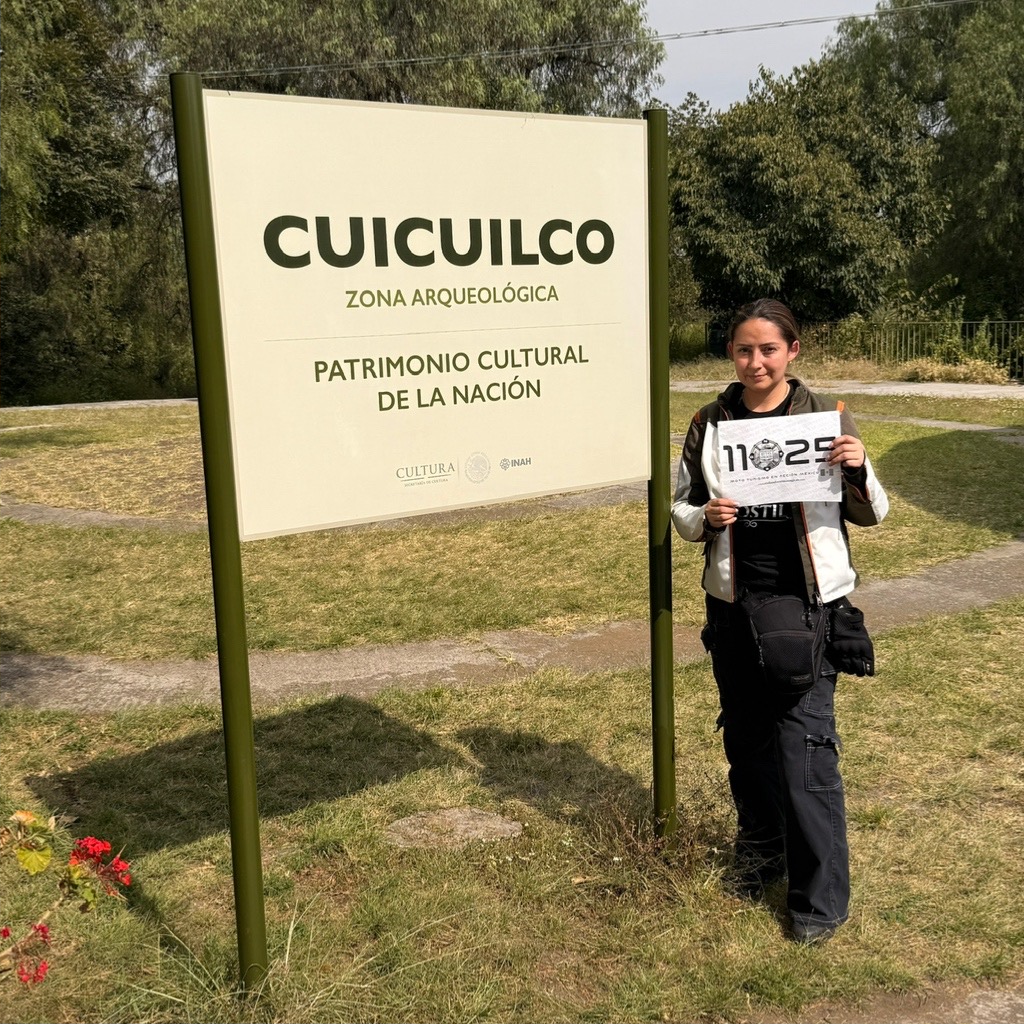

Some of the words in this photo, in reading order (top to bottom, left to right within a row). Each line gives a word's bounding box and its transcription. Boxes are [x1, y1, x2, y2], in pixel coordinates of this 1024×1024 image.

[263, 214, 615, 269] CUICUILCO
[345, 289, 407, 308] ZONA
[411, 282, 559, 307] ARQUEOLÓGICA
[314, 352, 470, 383] PATRIMONIO
[477, 345, 589, 371] CULTURAL
[378, 390, 409, 412] DE
[416, 387, 446, 408] LA
[452, 375, 541, 406] NACIÓN
[396, 462, 455, 479] CULTURA
[511, 457, 531, 467] INAH
